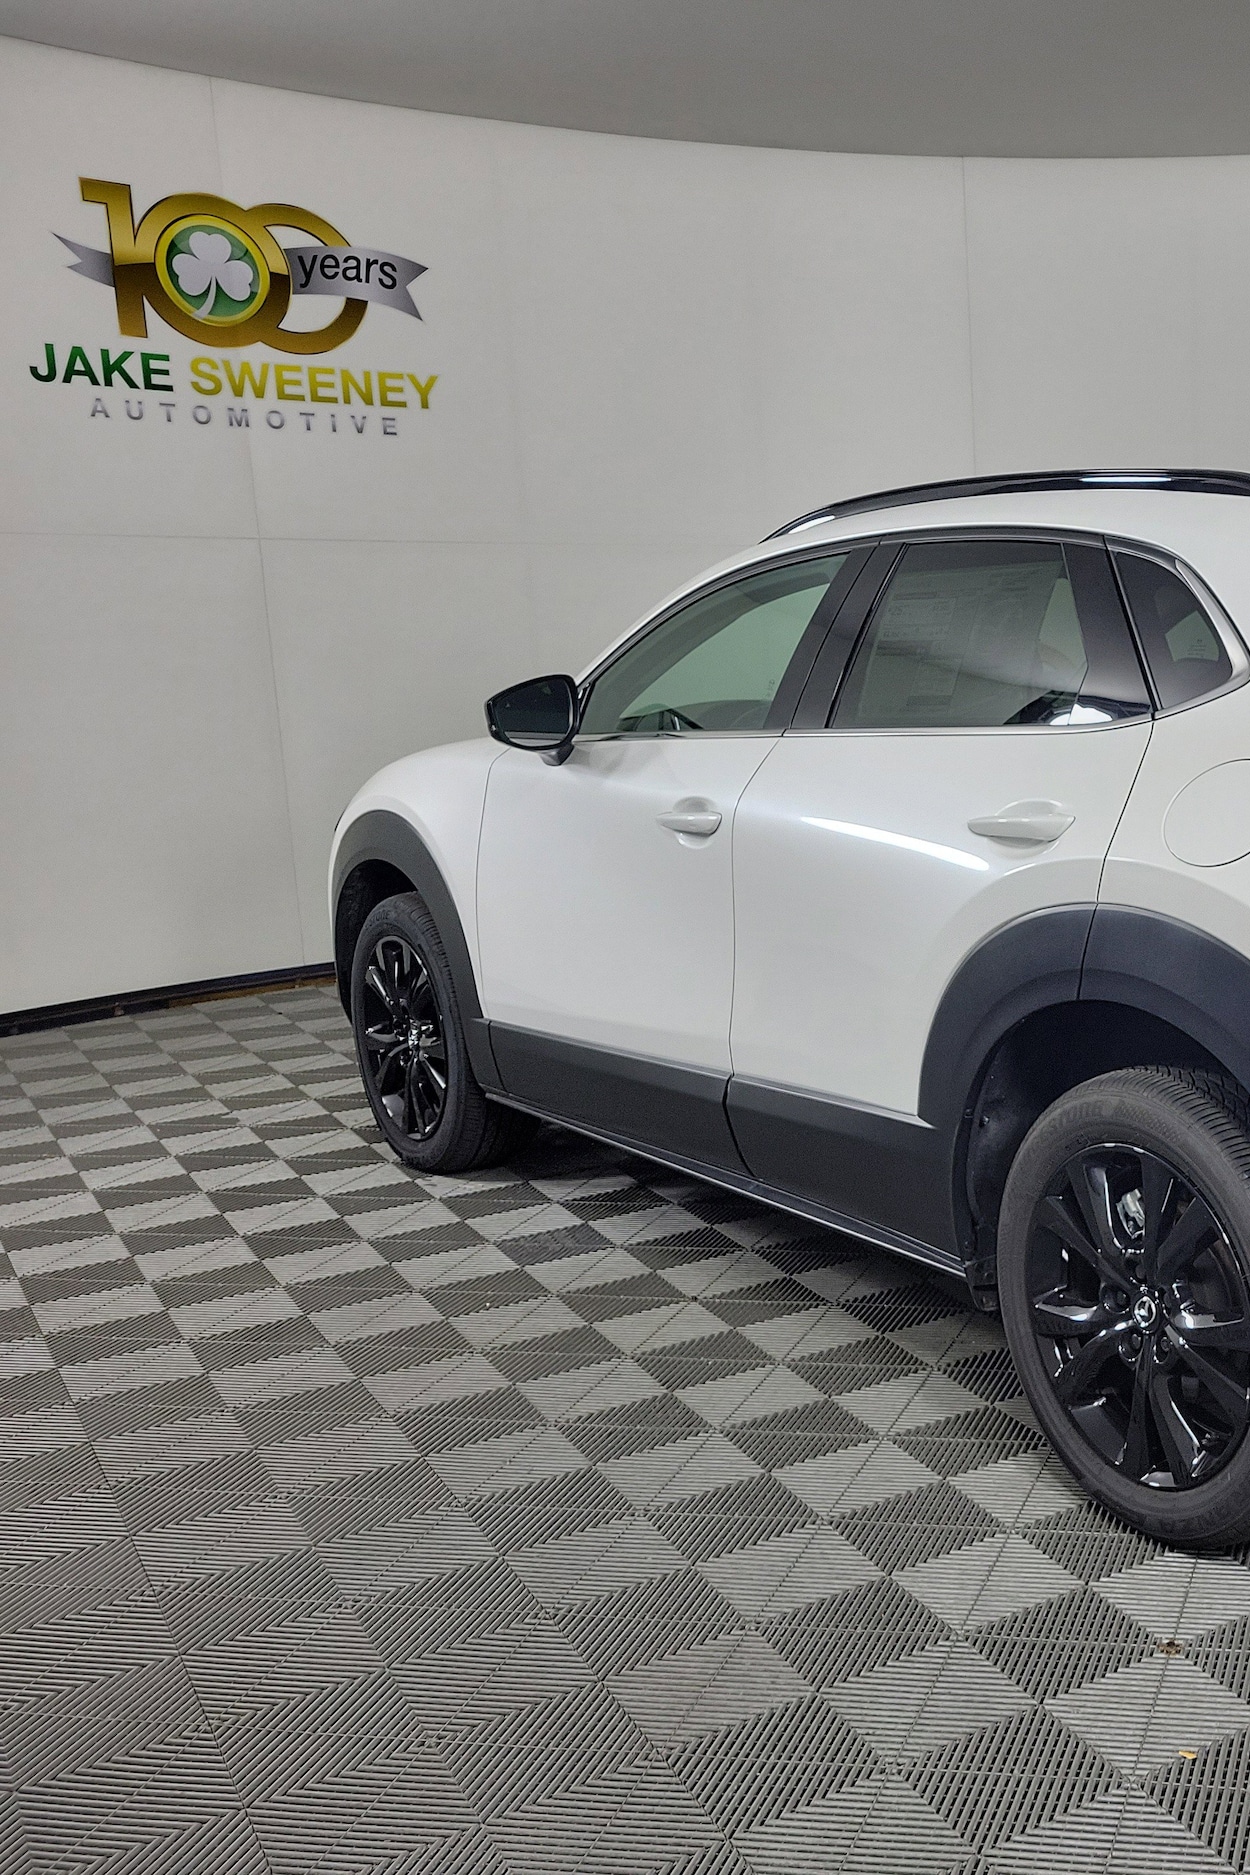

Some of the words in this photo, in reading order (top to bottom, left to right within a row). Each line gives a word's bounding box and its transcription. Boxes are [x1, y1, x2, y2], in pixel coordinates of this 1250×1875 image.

[79, 176, 369, 355] 100
[297, 252, 398, 290] years
[29, 343, 174, 392] JAKE
[189, 356, 439, 410] SWEENEY
[90, 397, 398, 437] AUTOMOTIVE
